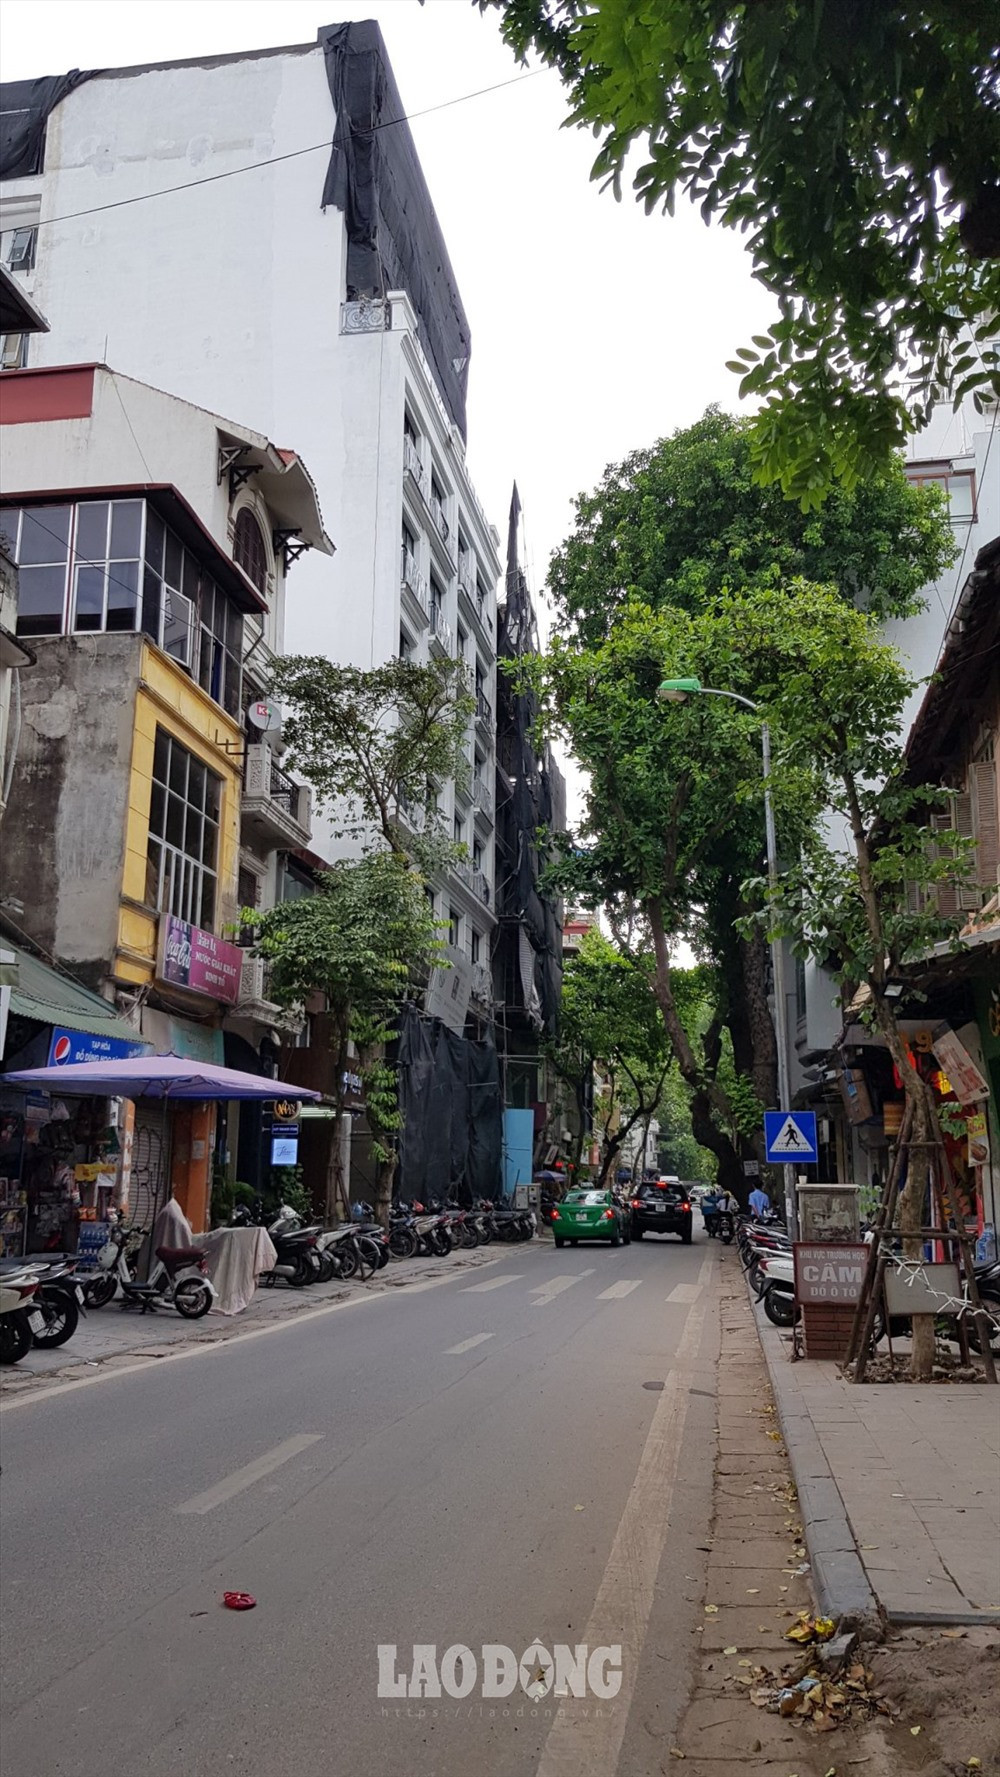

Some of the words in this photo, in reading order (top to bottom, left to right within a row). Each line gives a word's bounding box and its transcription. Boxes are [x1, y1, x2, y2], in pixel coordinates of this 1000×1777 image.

[91, 1041, 100, 1051] TẠP
[800, 1250, 812, 1259] KHU
[813, 1250, 826, 1261] VỰC
[852, 1251, 865, 1261] HỌC
[803, 1261, 862, 1283] CẤM
[830, 1285, 839, 1297] Ô
